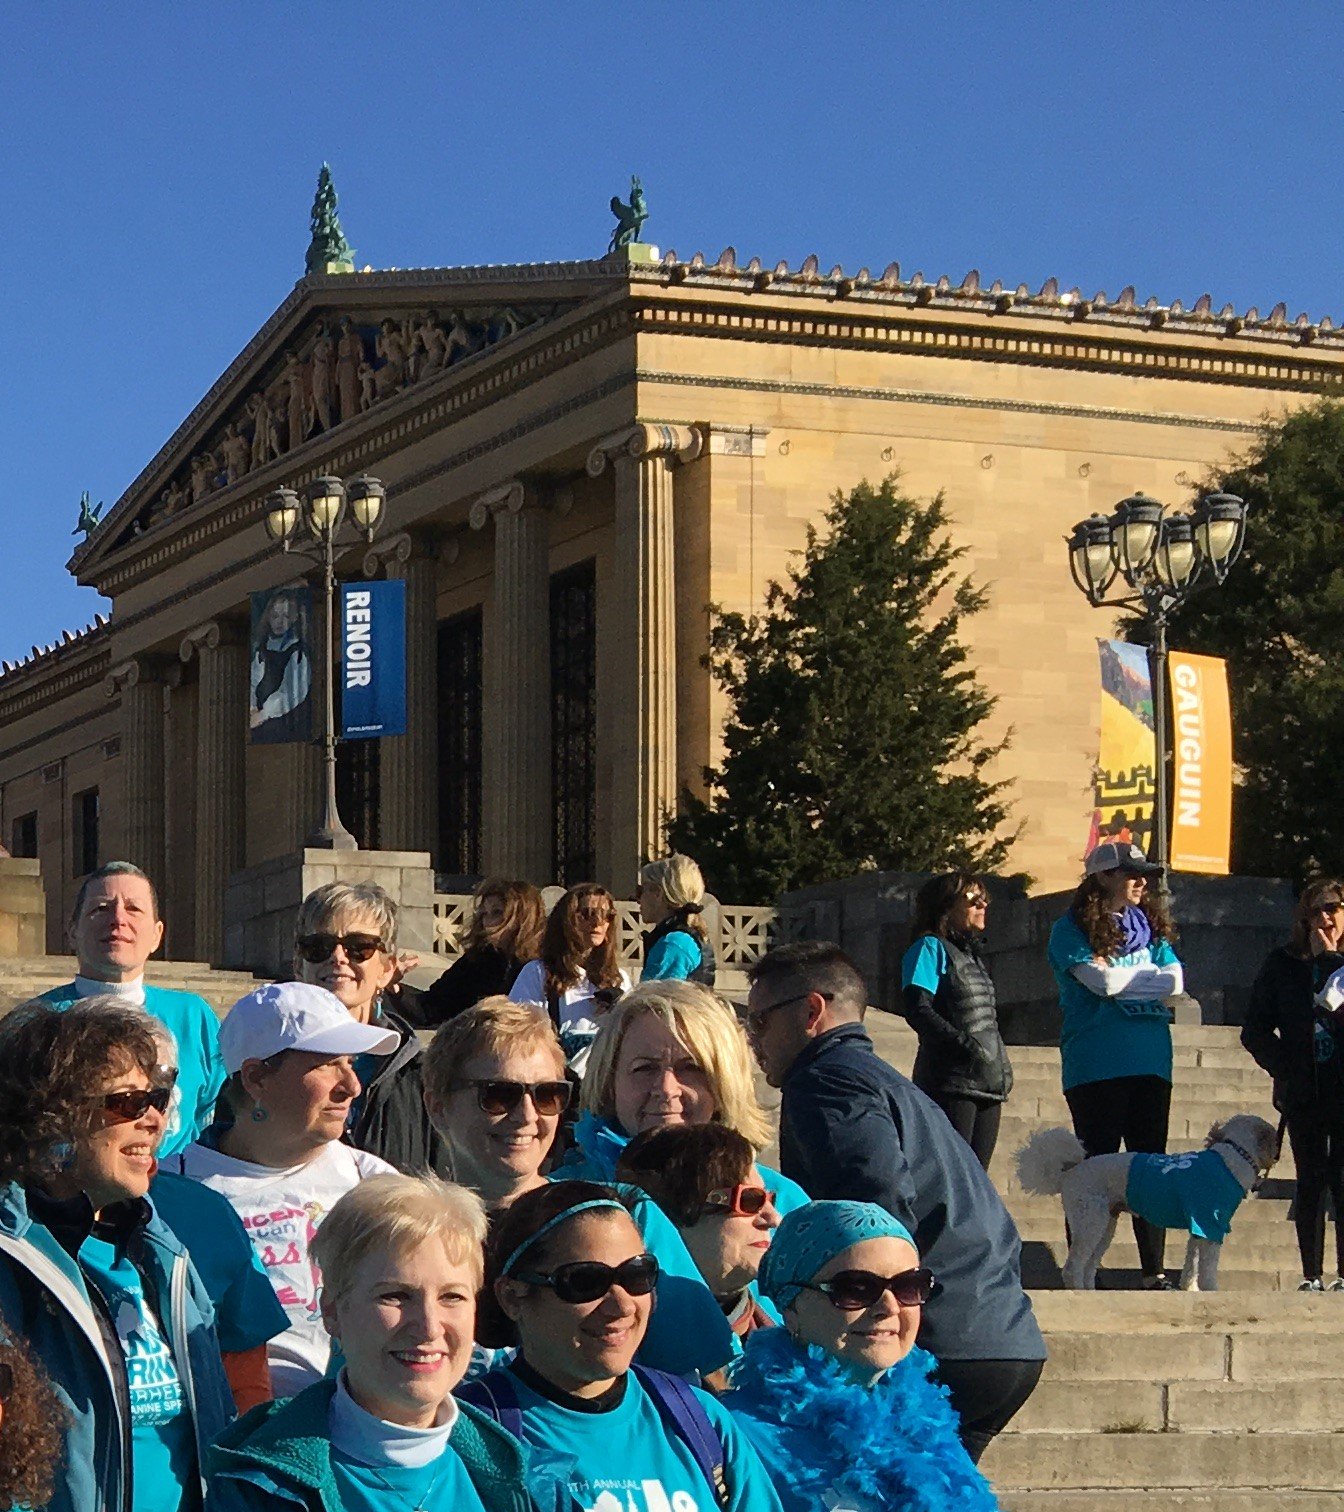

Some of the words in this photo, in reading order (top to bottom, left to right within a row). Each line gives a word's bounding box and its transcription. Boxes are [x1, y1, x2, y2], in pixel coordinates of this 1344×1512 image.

[346, 590, 371, 689] RENOIR
[1174, 664, 1201, 828] GAUGUIN
[593, 1478, 642, 1490] ANNUAL
